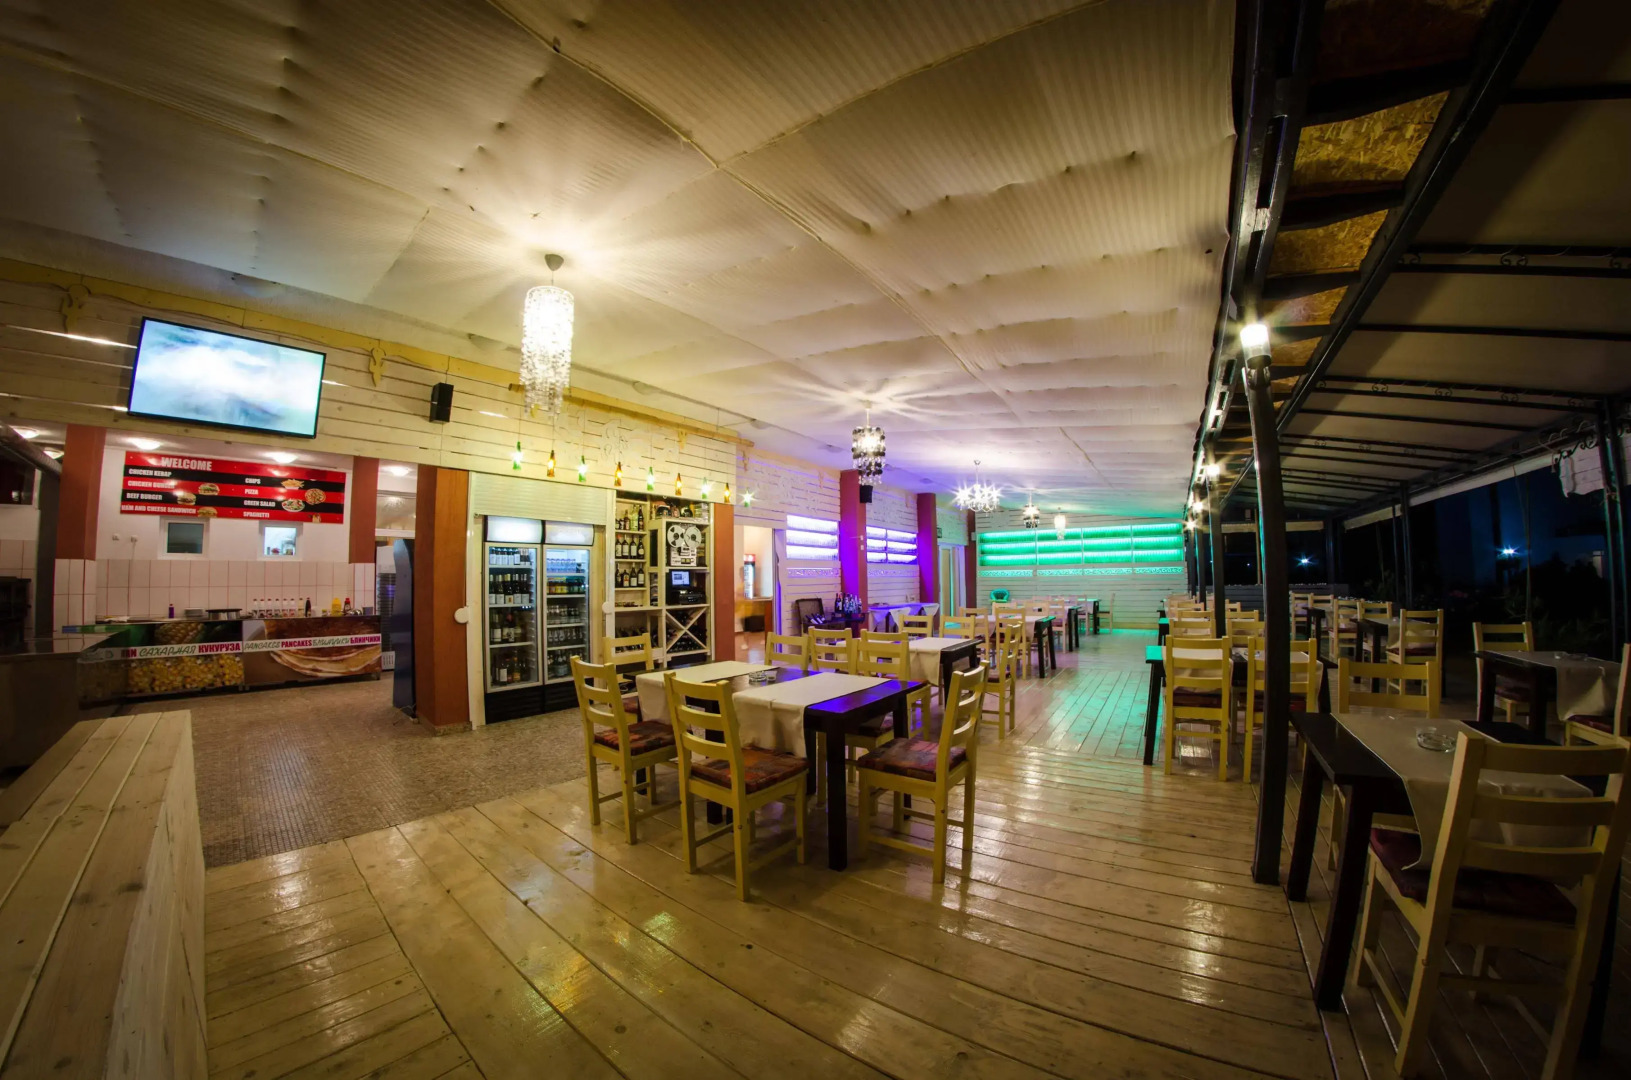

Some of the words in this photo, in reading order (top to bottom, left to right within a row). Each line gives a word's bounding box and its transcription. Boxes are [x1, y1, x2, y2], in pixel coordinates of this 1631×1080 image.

[160, 457, 212, 471] WELCOME
[128, 468, 153, 476] CHICKEN
[127, 480, 152, 488] CHICKEN
[245, 477, 261, 485] CHIPS
[126, 492, 139, 500] BEEF
[140, 493, 163, 501] BURGER
[243, 499, 259, 507] GREEN
[167, 506, 196, 514] SANDWICH
[281, 639, 312, 648] PANCAKES
[350, 635, 381, 644] БЛИНЧИКИ
[139, 645, 197, 657] САХАРНАЯ
[198, 642, 240, 653] КУКУРУЗА
